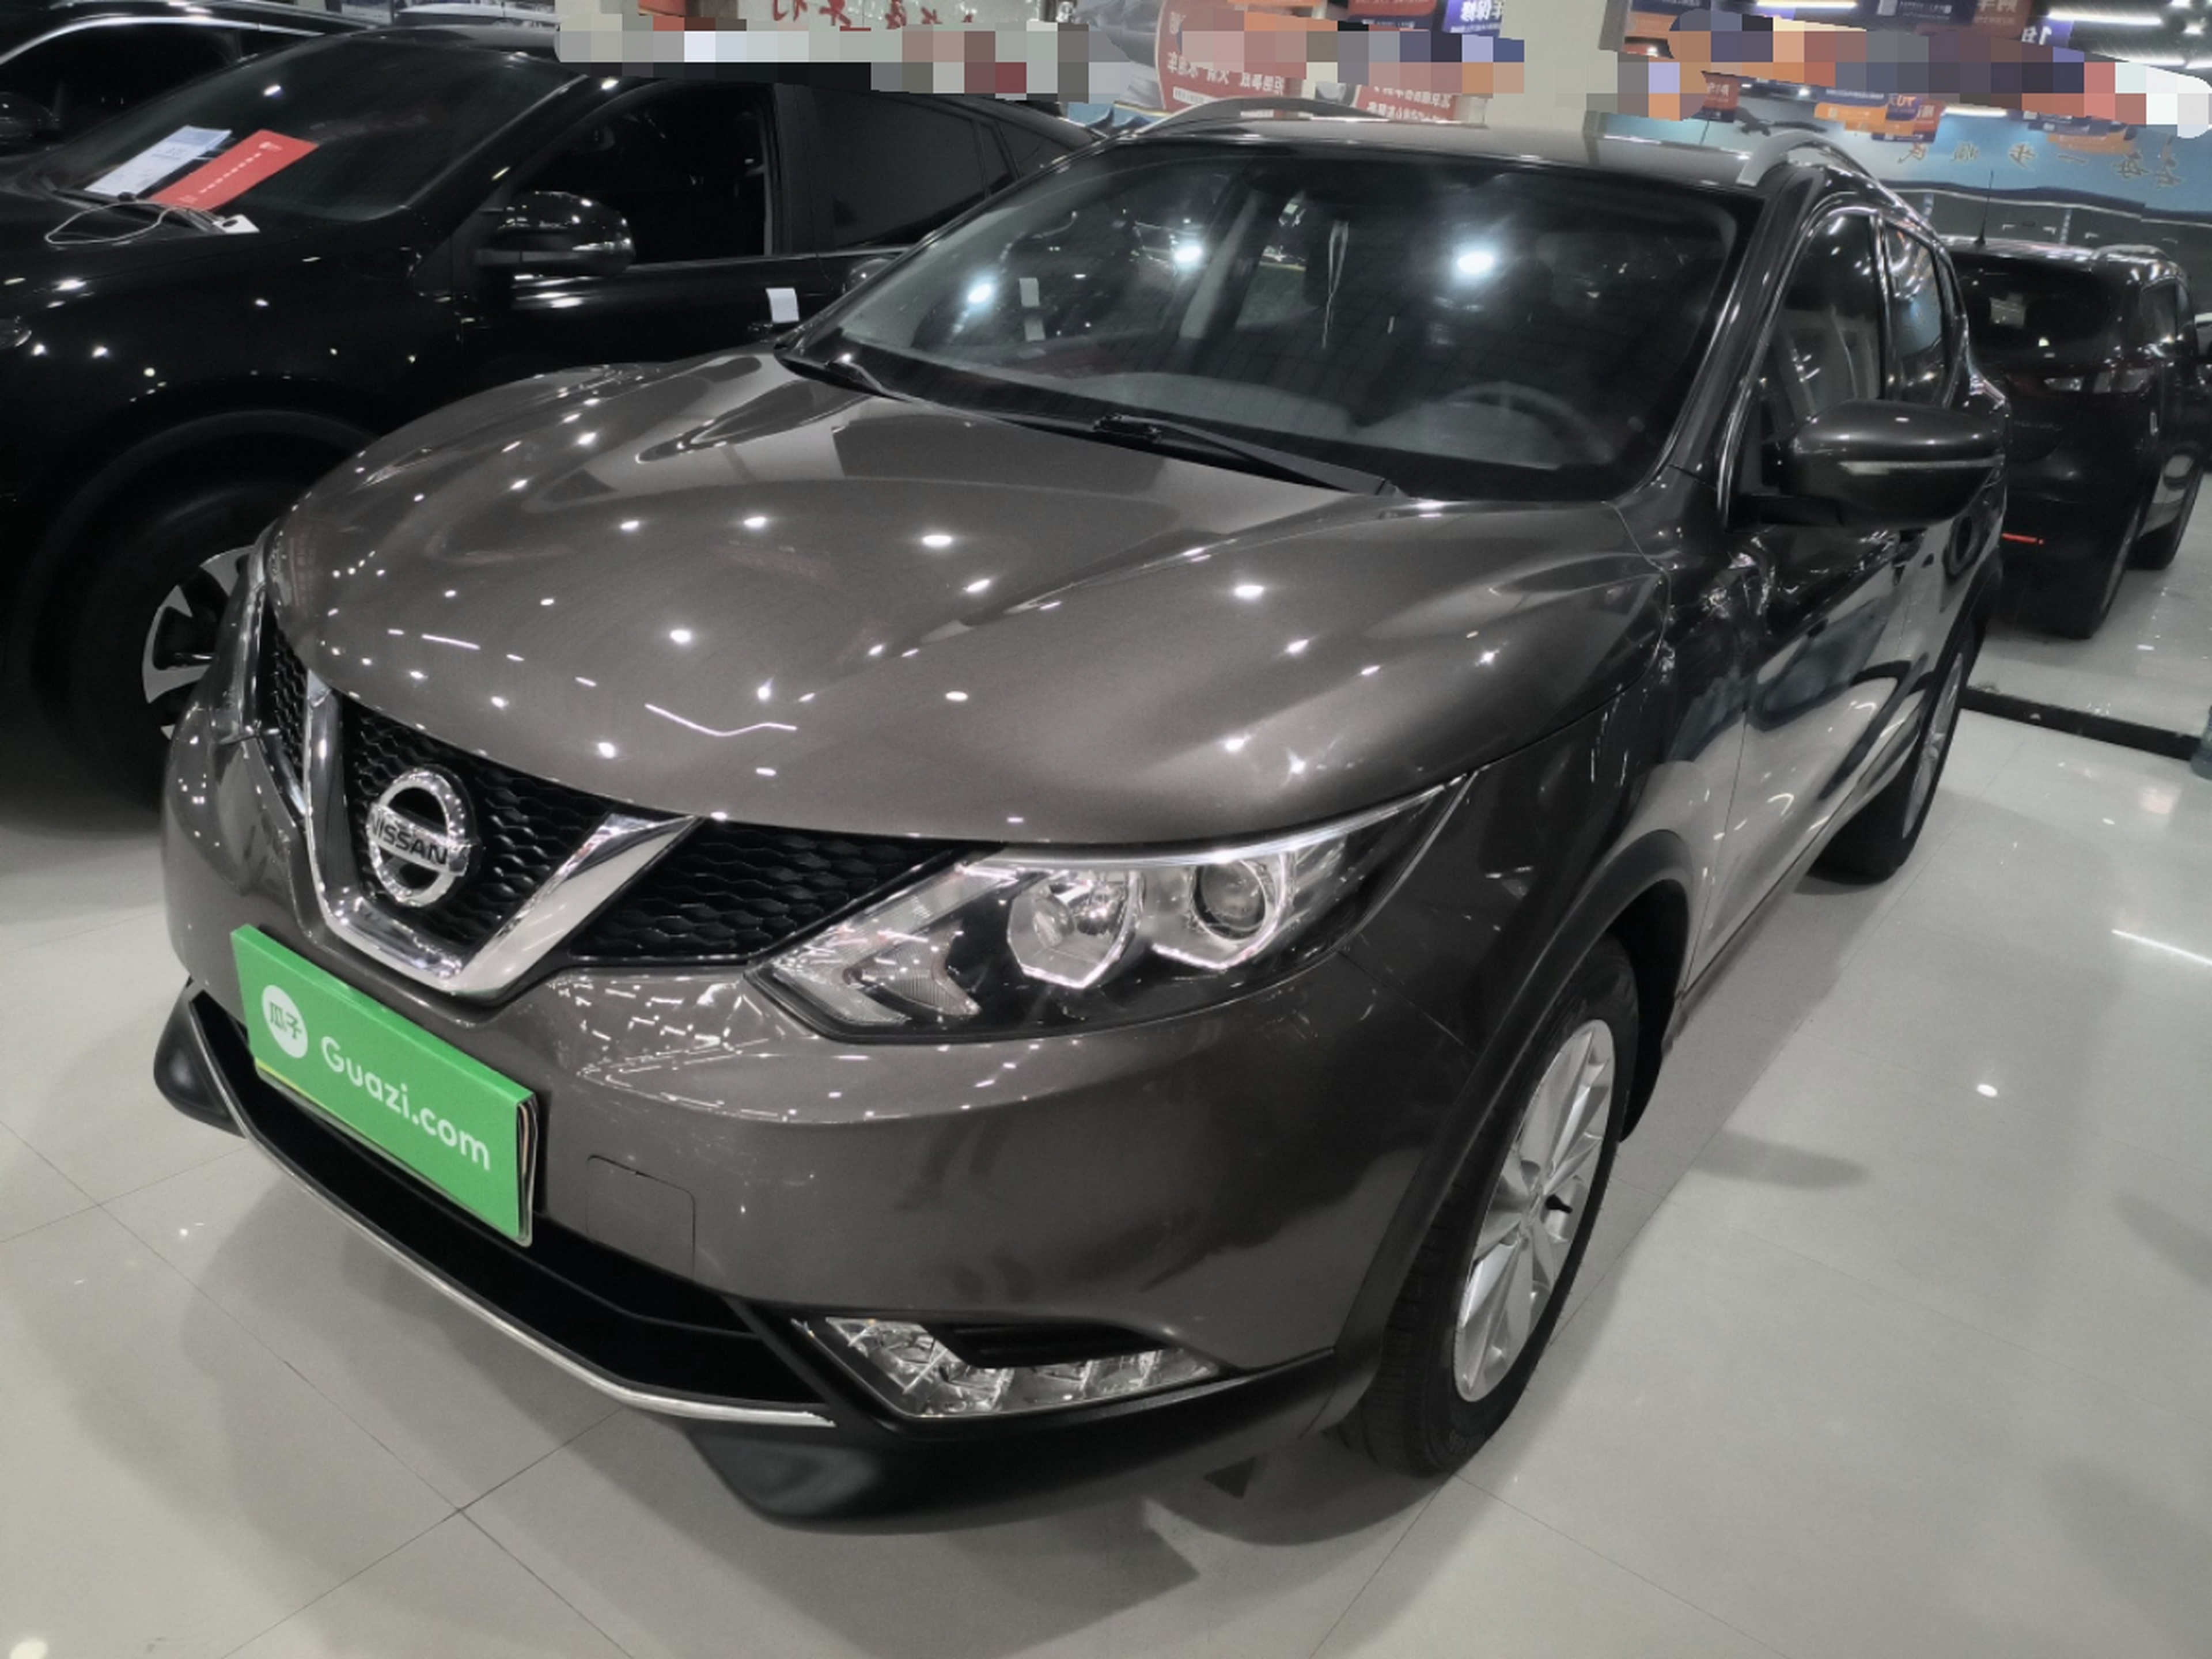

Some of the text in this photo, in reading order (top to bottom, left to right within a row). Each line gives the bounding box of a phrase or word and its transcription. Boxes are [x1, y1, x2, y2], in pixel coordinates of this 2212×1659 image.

[372, 809, 448, 865] NISSAN
[269, 1002, 302, 1040] 瓜子
[321, 1036, 490, 1171] Guazi.com
